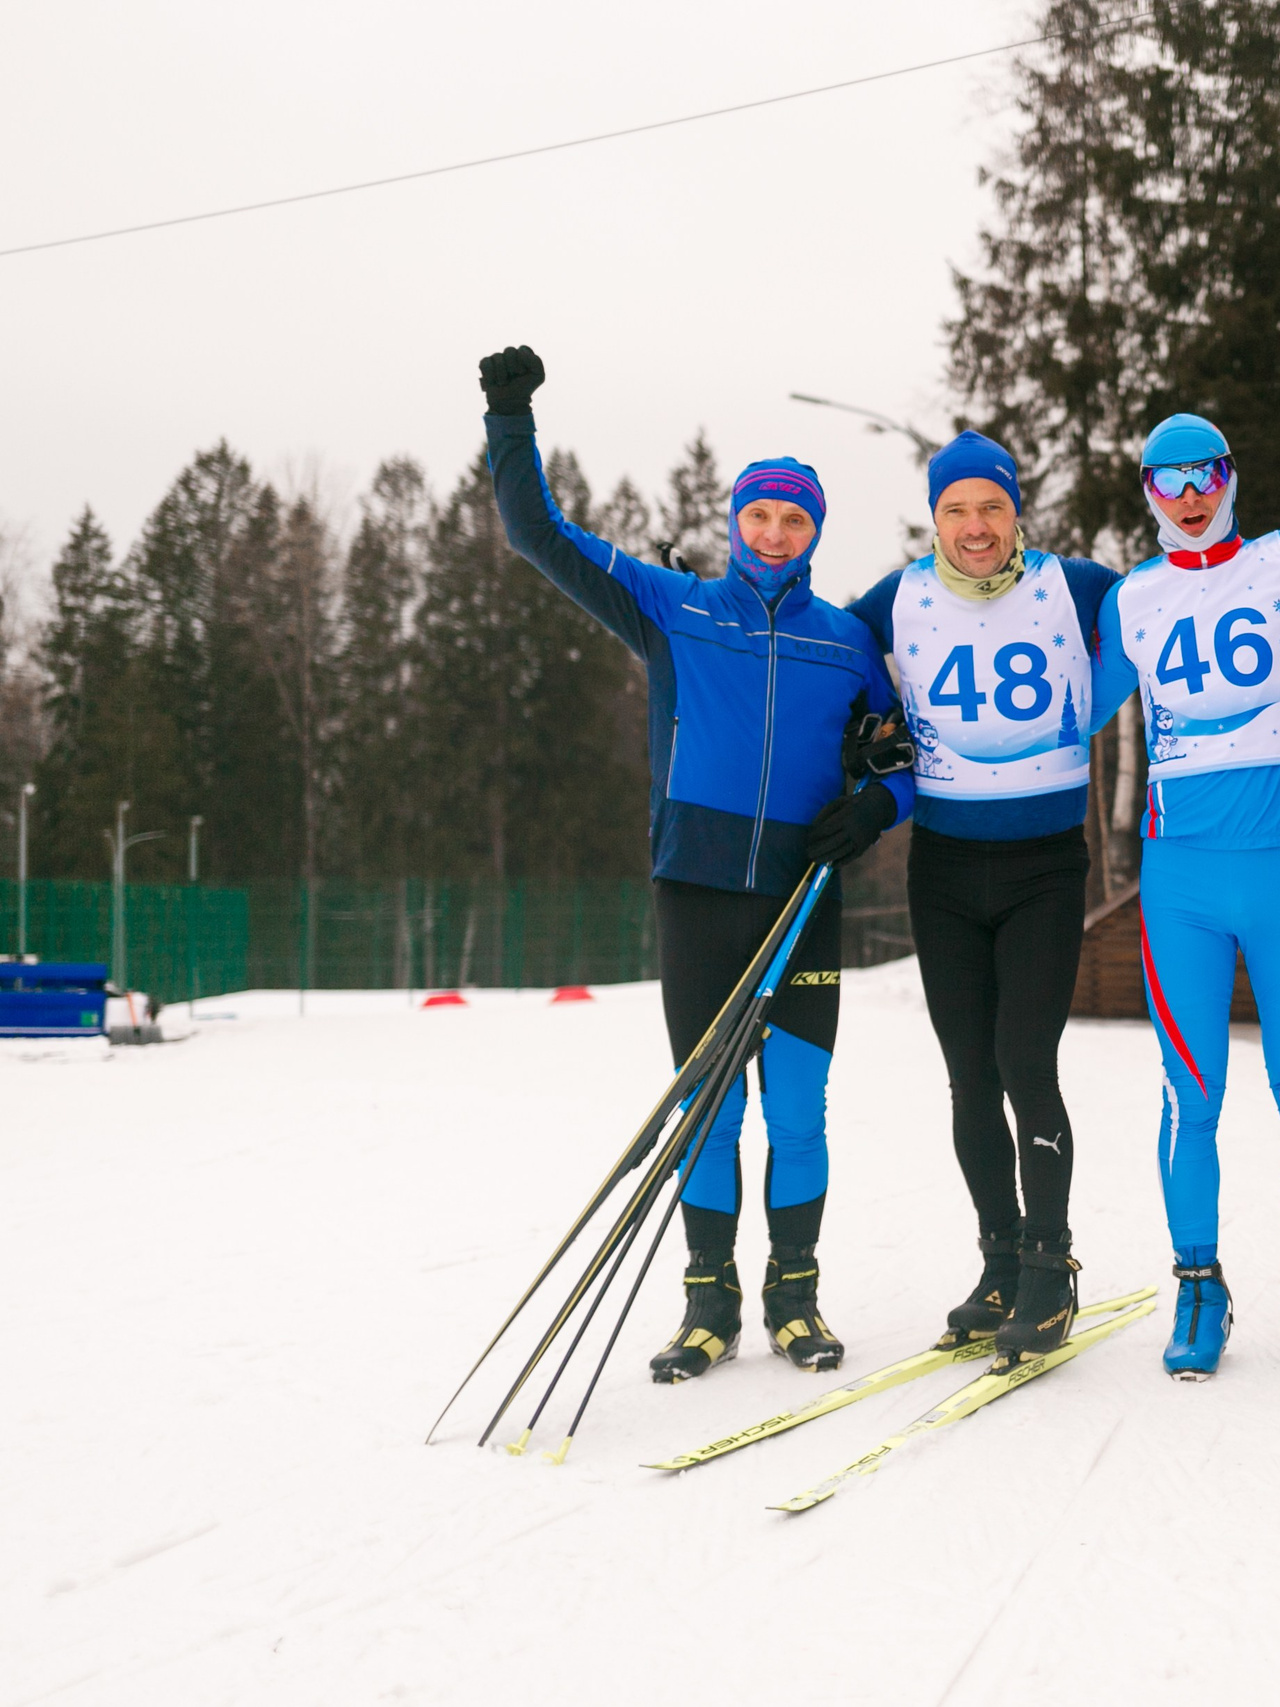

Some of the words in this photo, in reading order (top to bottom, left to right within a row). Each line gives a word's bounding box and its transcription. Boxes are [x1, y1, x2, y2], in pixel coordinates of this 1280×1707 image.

[1155, 607, 1273, 695] 46
[928, 642, 1052, 723] 48
[1177, 1268, 1212, 1277] SPINE
[1037, 1309, 1069, 1332] FISCHER
[953, 1340, 996, 1362] FISCHE
[1008, 1358, 1045, 1386] FISCHER
